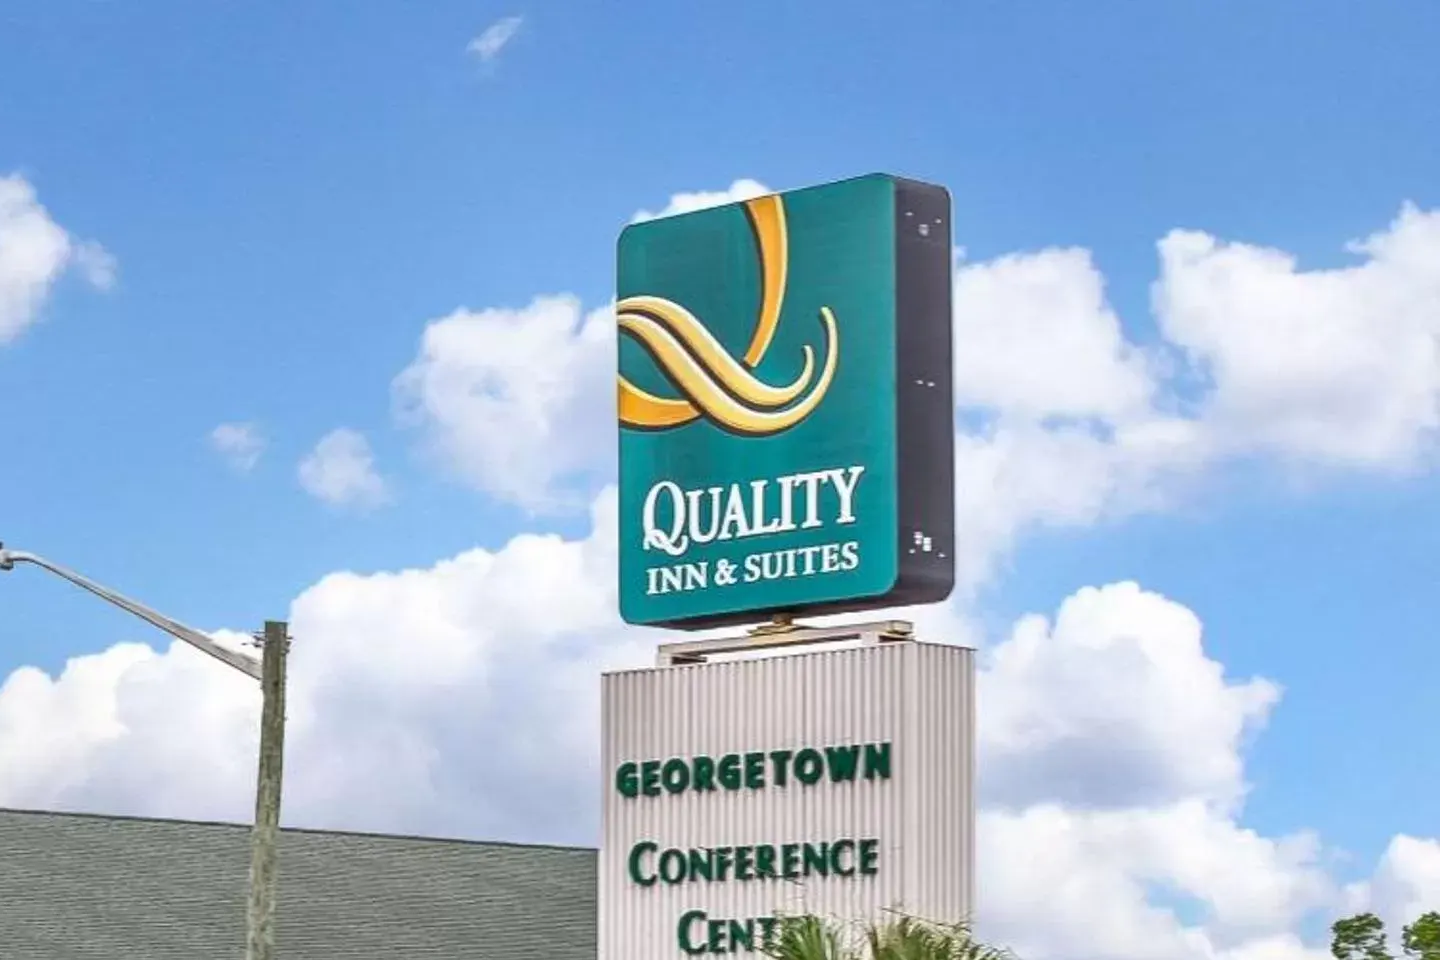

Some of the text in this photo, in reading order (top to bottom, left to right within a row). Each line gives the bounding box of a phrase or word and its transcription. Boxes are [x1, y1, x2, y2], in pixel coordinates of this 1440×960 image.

[643, 466, 864, 556] QUALITY
[646, 541, 859, 595] INN & SUITES
[616, 742, 891, 798] GEORGETOWN
[629, 838, 878, 887] CONFERENCE
[678, 910, 777, 956] CENT
